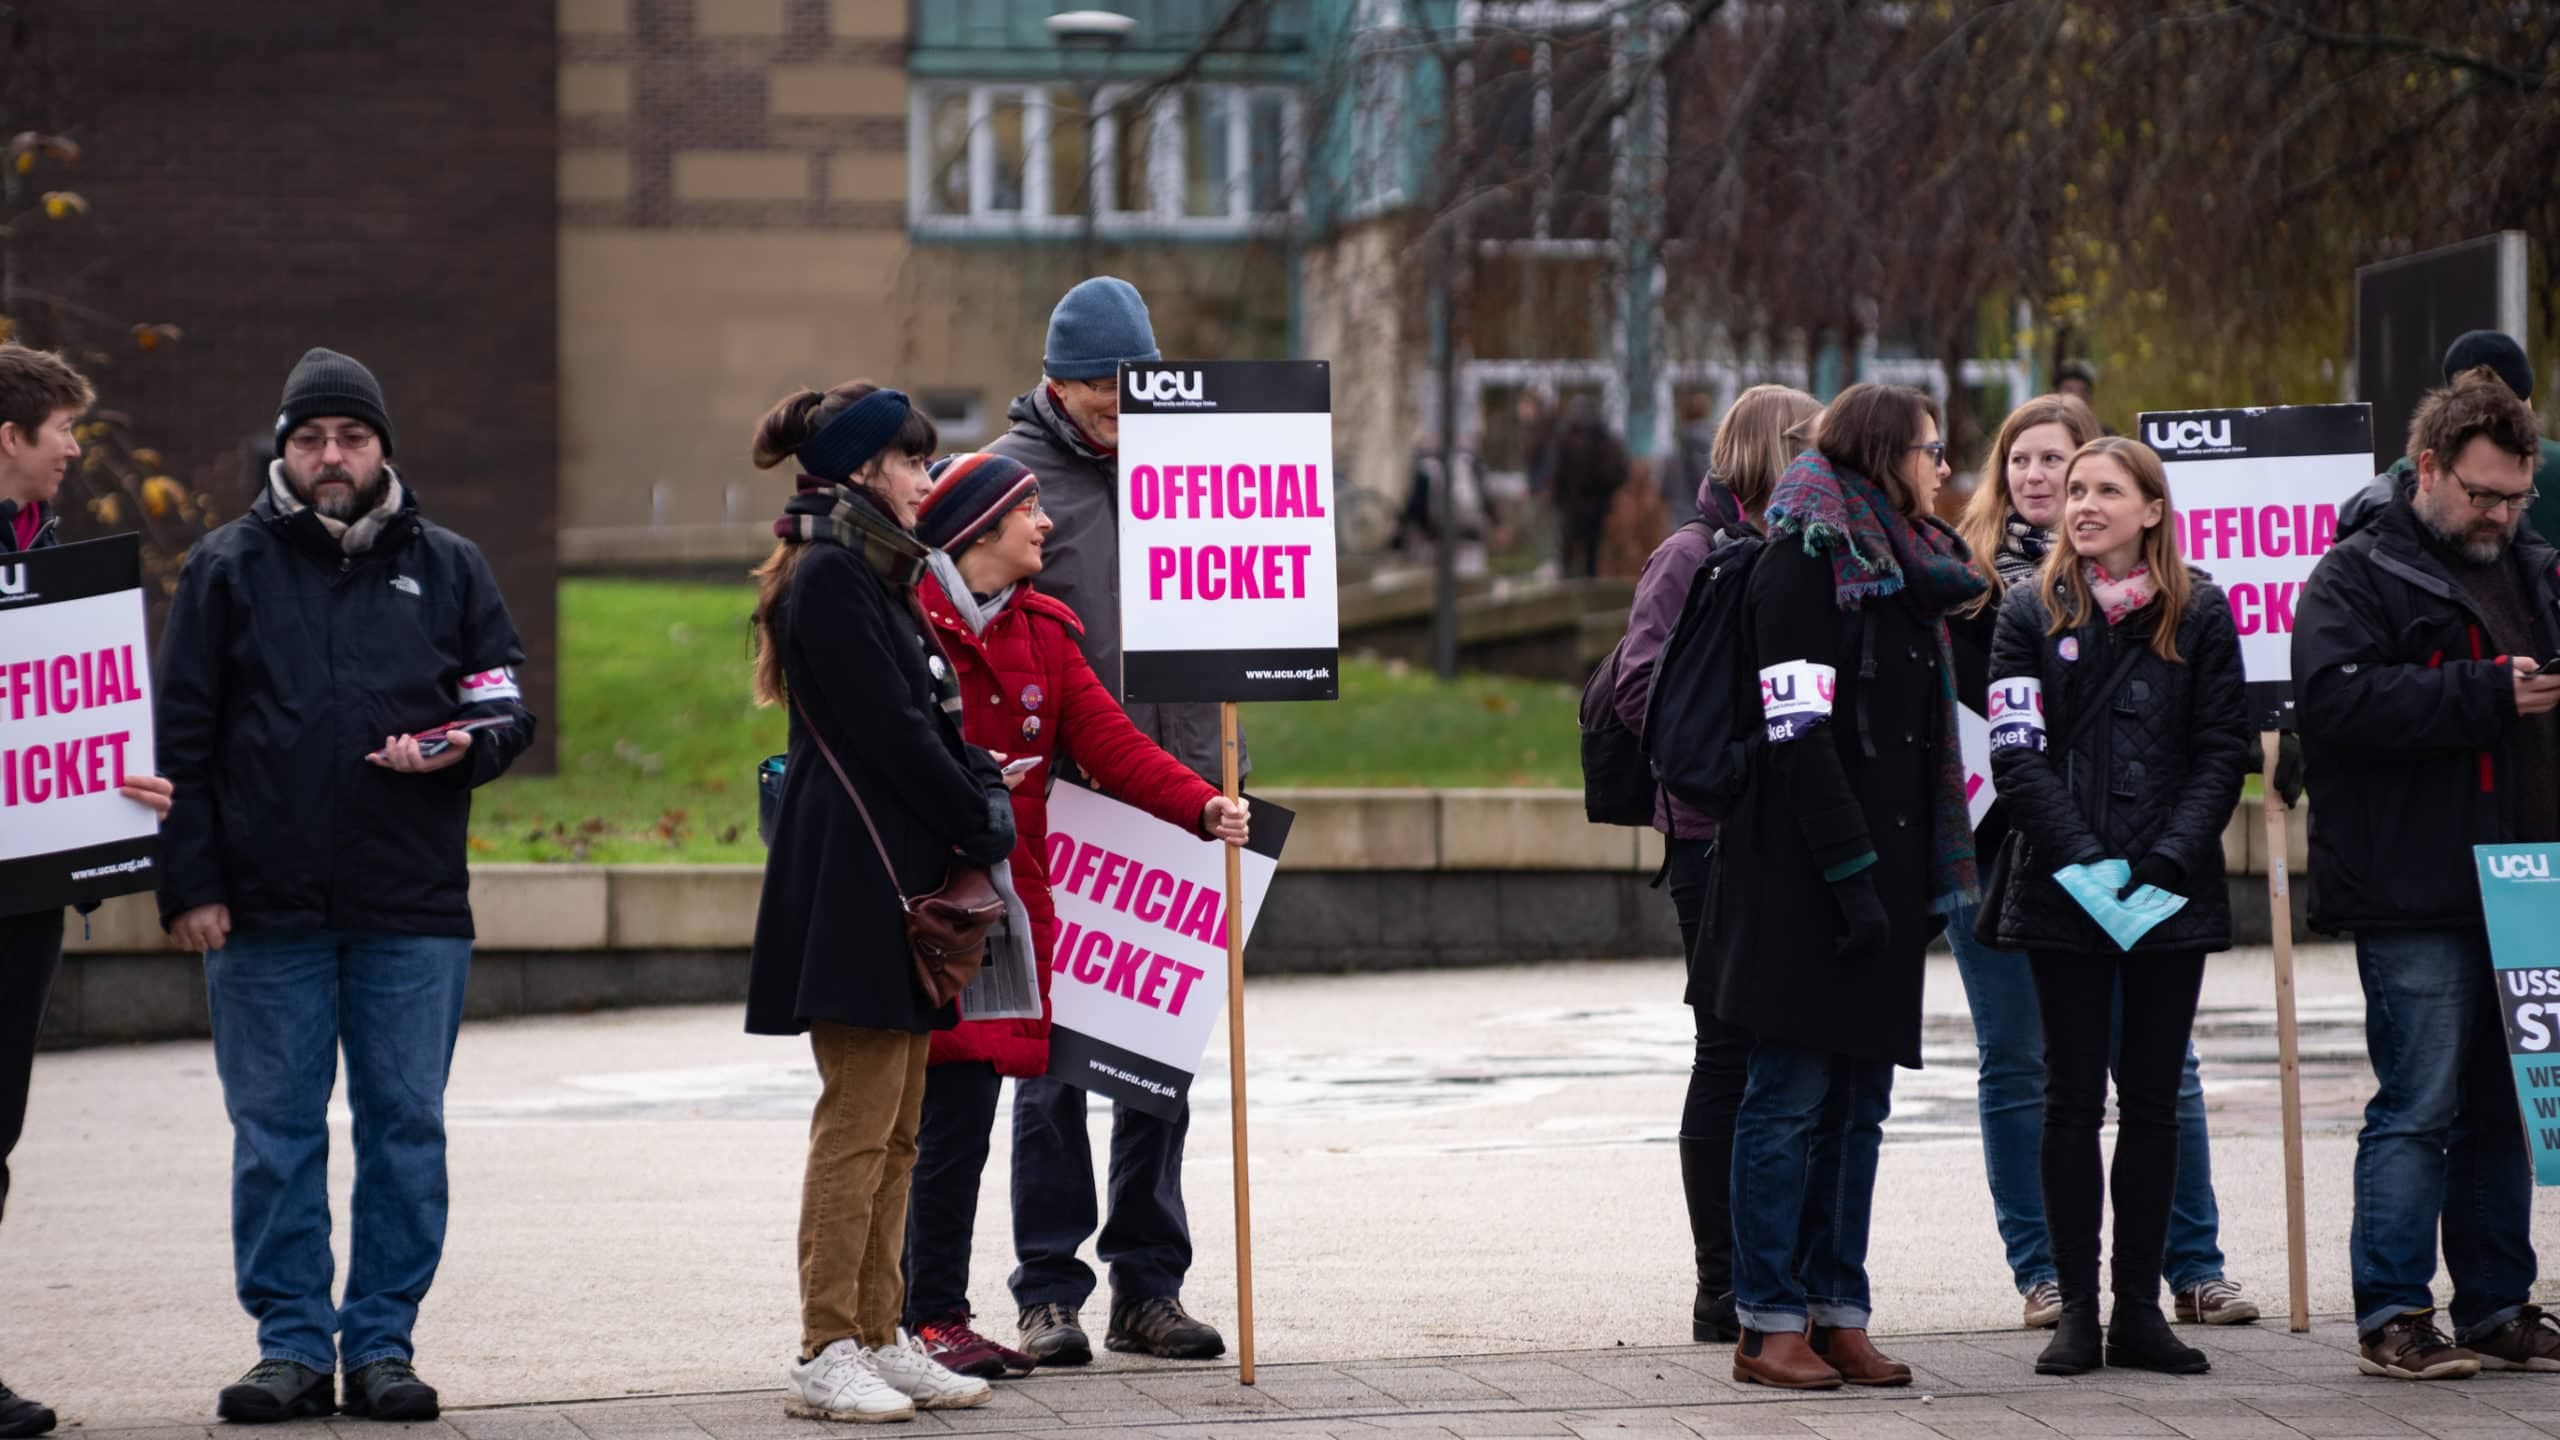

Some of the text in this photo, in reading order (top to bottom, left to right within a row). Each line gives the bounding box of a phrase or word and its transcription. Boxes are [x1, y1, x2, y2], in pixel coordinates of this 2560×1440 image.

[1130, 464, 1325, 520] OFFICIAL
[2173, 504, 2338, 561] FFICIA
[1148, 545, 1311, 600] PICKET
[0, 644, 142, 720] FICIAL
[1246, 667, 1330, 680] www.ucu.org.uk
[1767, 719, 1795, 742] ket
[1991, 727, 2028, 751] cket
[3, 730, 130, 807] ICKET
[1089, 1059, 1177, 1098] www.ucu.org.uk
